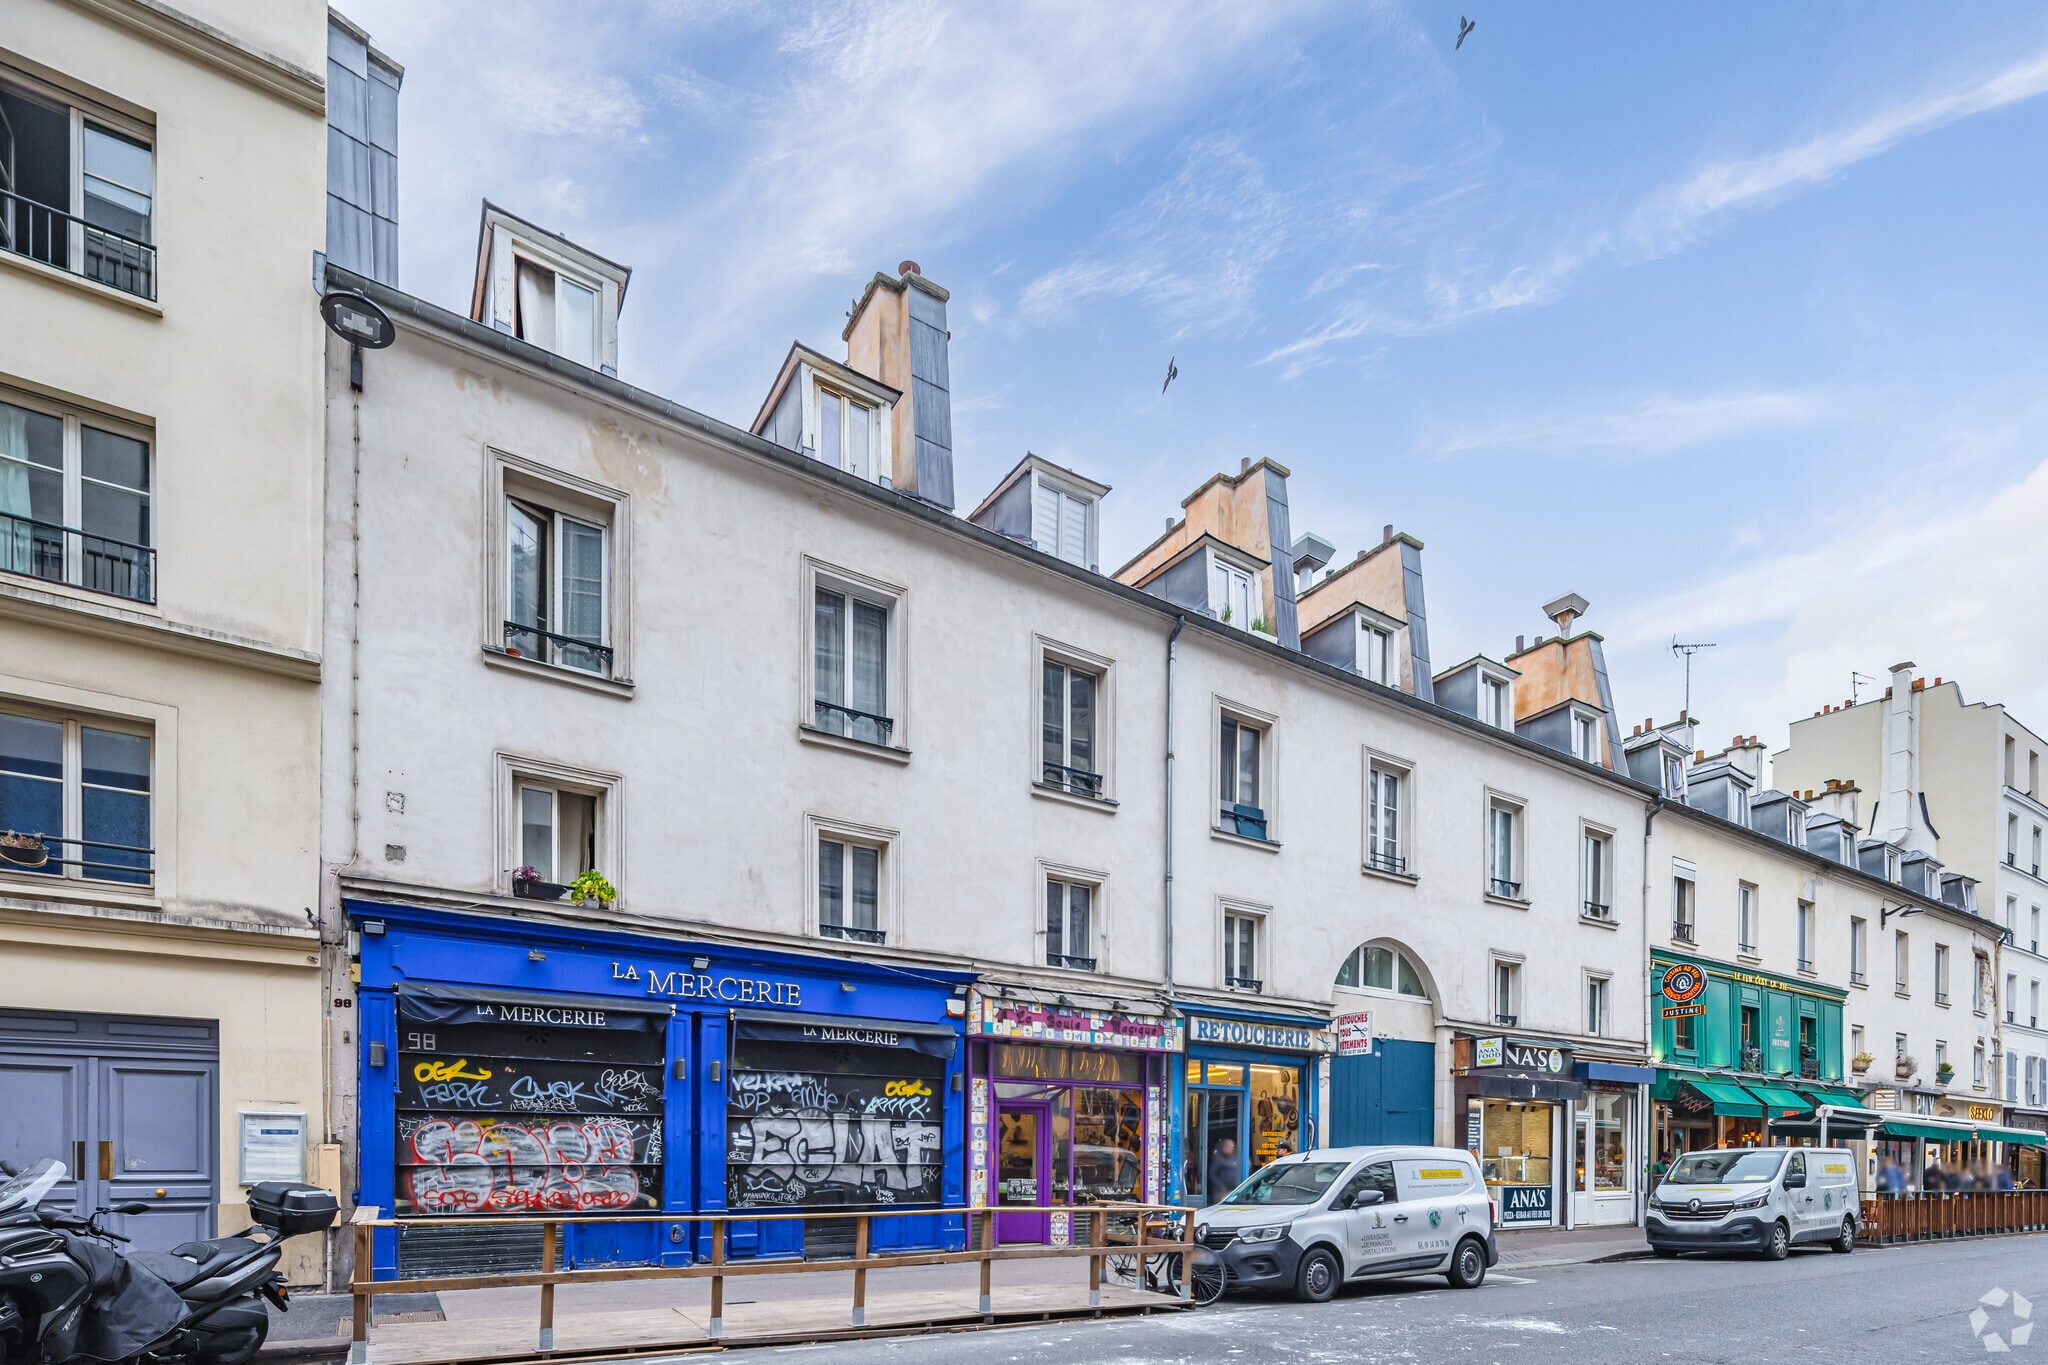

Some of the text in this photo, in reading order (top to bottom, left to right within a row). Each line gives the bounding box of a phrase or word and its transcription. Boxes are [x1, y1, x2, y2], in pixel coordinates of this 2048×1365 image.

[612, 962, 802, 1006] LA MERCERIE
[334, 999, 352, 1008] 98
[1664, 1007, 1699, 1017] JUSTINE
[476, 1005, 606, 1026] LA MERCERIE
[1340, 1013, 1368, 1026] RETOUCHES
[408, 1033, 436, 1051] 98
[803, 1027, 899, 1046] LA MERCERIE
[1197, 1020, 1311, 1049] RETOUCHERIE
[1340, 1028, 1351, 1038] TOUS
[1506, 1047, 1547, 1067] NA'S
[1510, 1189, 1546, 1208] ANA'S
